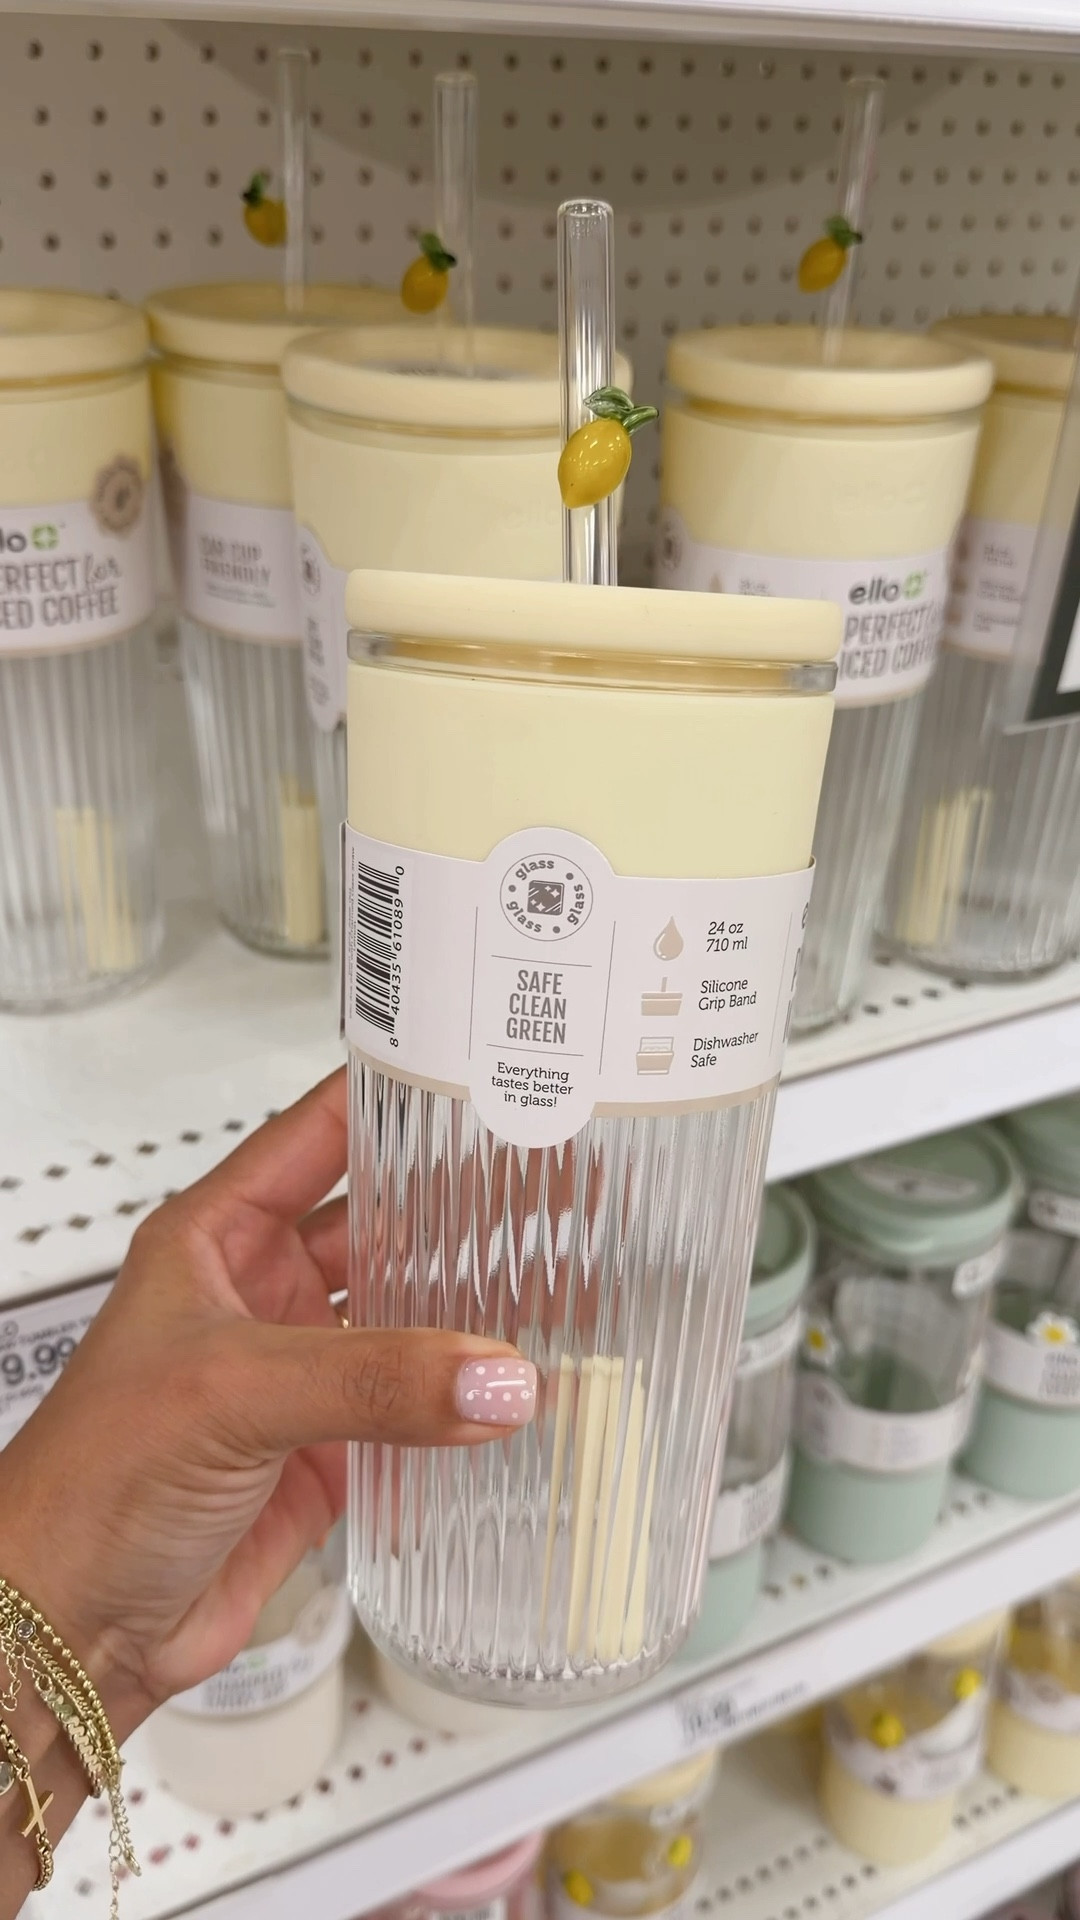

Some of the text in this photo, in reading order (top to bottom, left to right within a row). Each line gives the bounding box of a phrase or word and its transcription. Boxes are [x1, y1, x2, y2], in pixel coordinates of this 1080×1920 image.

[848, 576, 899, 605] ello
[42, 587, 120, 627] COFFEE
[843, 606, 926, 646] PERFECT
[840, 649, 887, 680] ICED
[515, 860, 555, 881] glass
[506, 901, 542, 933] glass
[567, 884, 585, 926] glass
[708, 921, 744, 935] 24 oz
[706, 936, 748, 952] 710 ml
[390, 866, 405, 1047] 8 40435 61089 0
[517, 969, 563, 995] SAFE
[700, 979, 749, 994] Silicone
[509, 993, 567, 1020] CLEAN
[698, 991, 757, 1012] Grip Band
[506, 1017, 567, 1044] GREEN
[693, 1032, 759, 1051] Dishwasher
[497, 1061, 570, 1083] Everything
[690, 1054, 717, 1068] Safe
[491, 1075, 574, 1095] tastes better
[504, 1091, 557, 1108] in glass!
